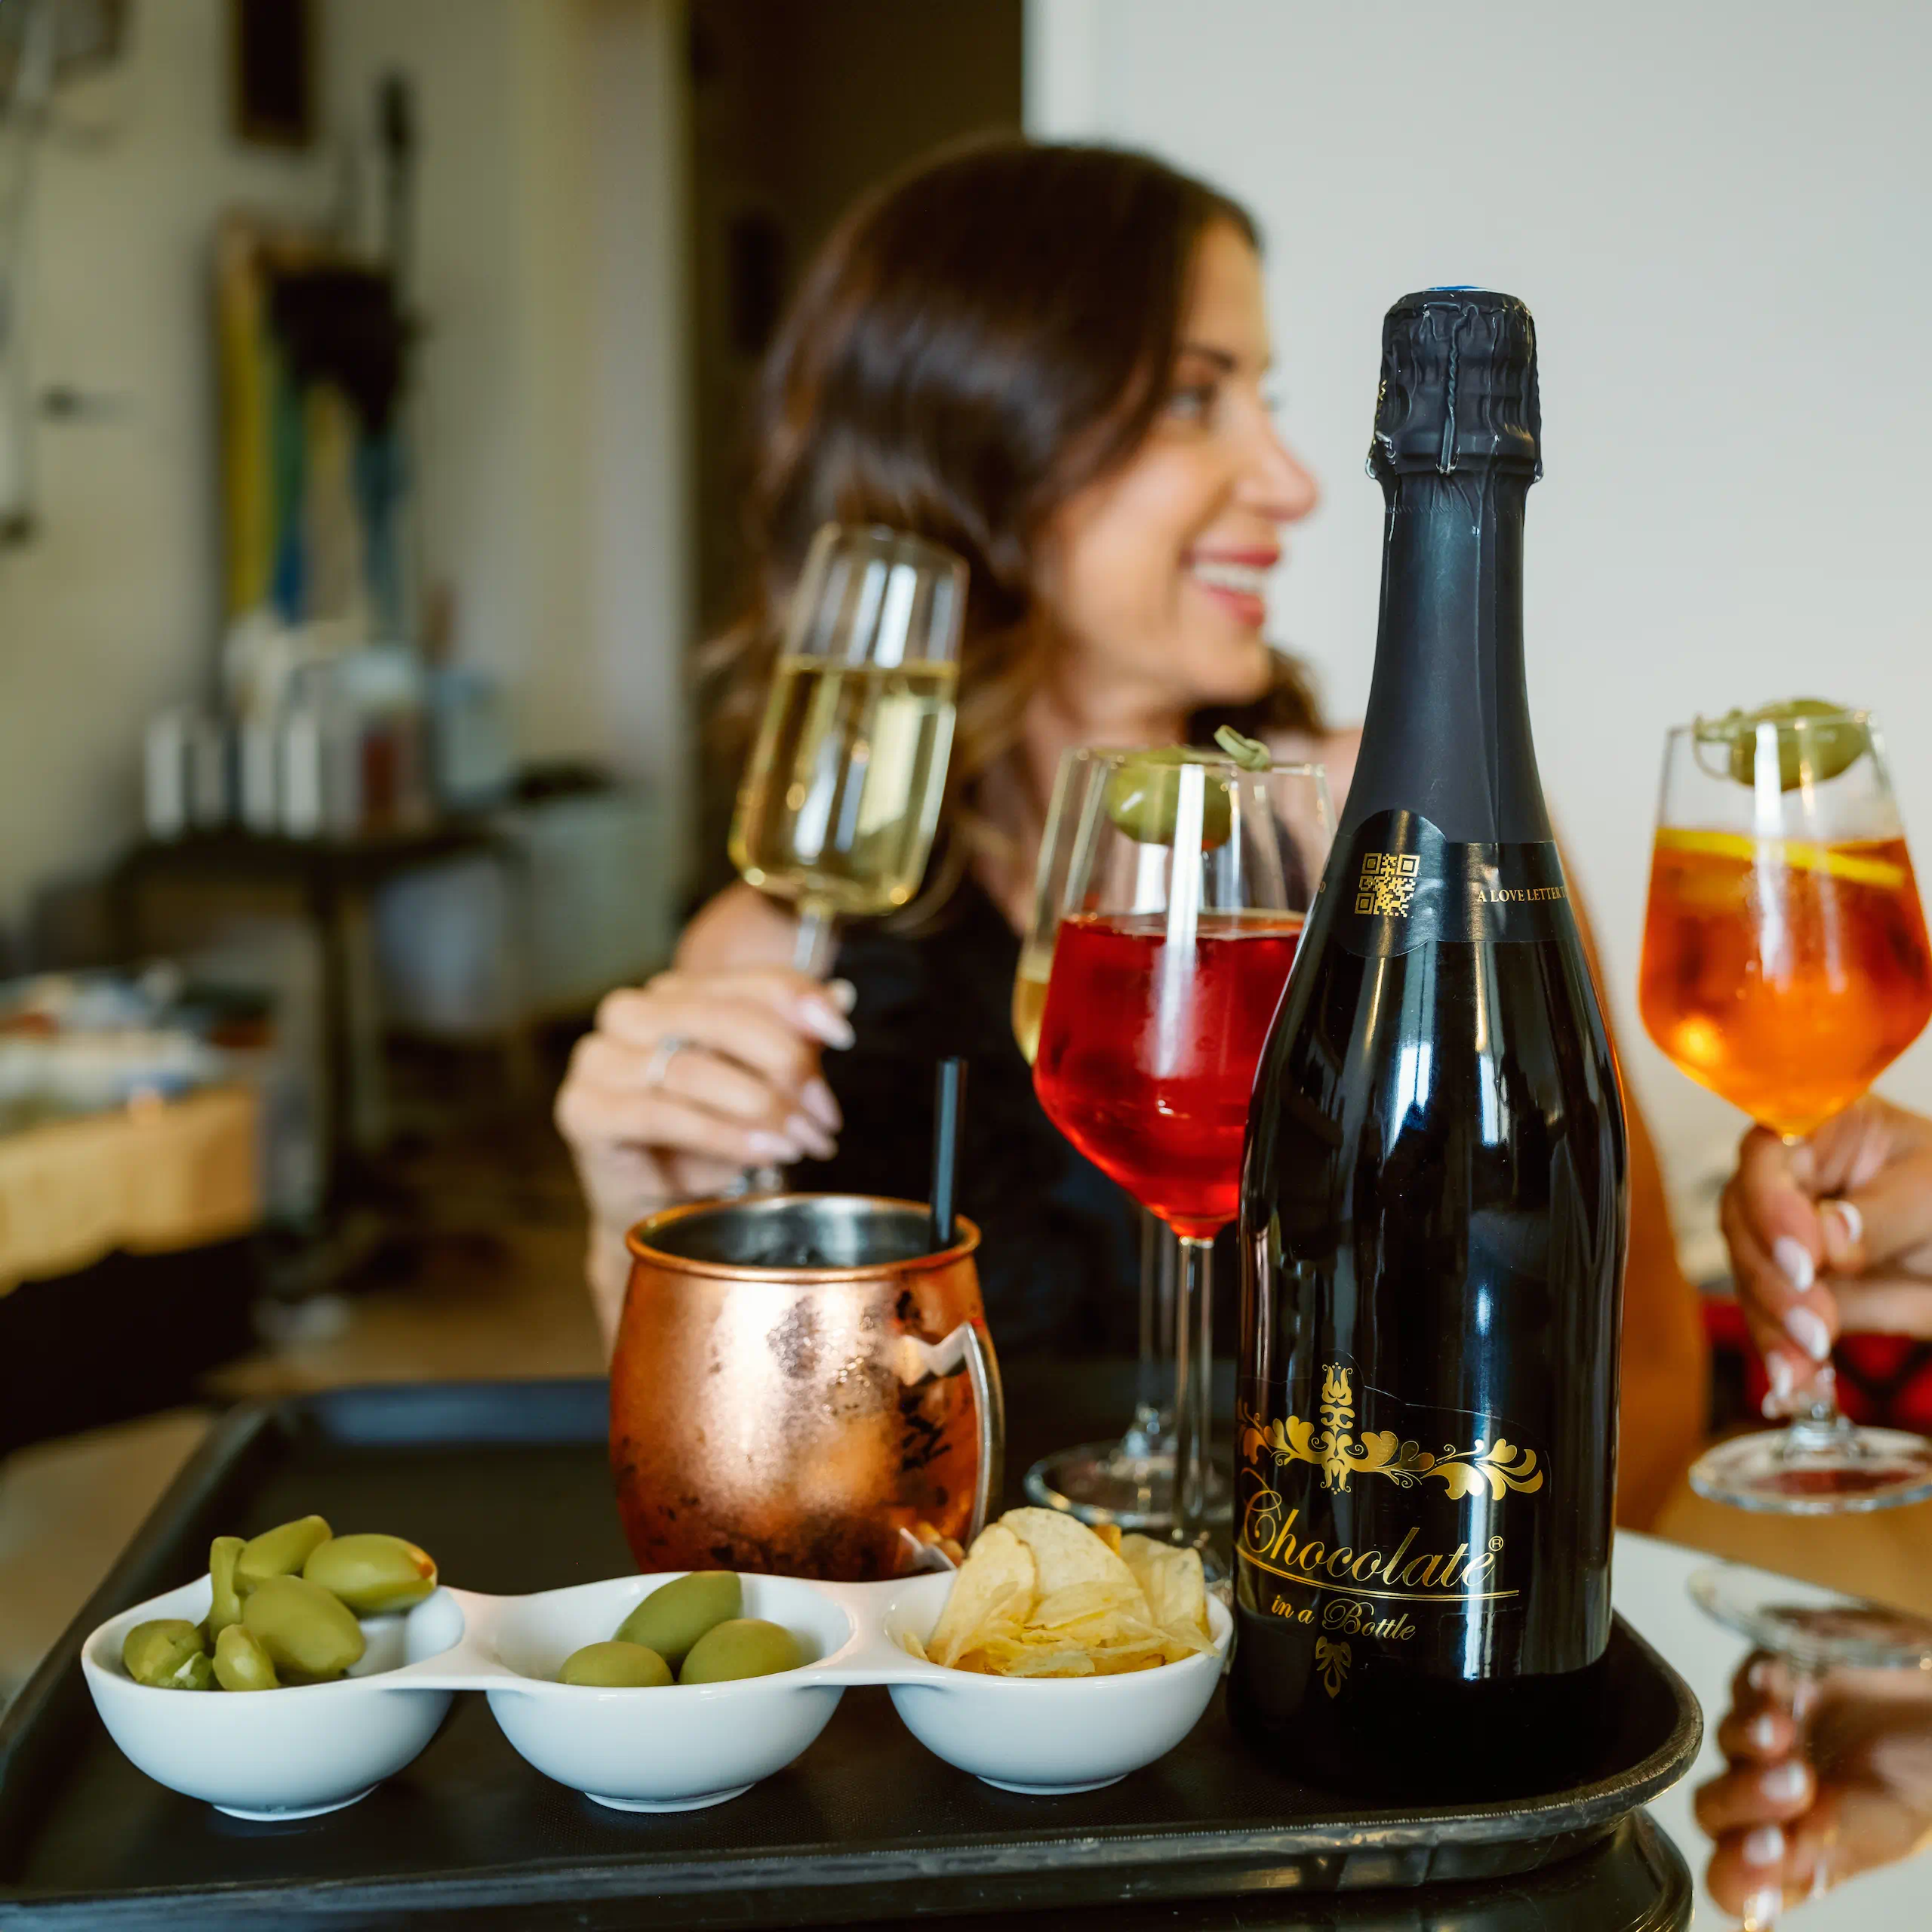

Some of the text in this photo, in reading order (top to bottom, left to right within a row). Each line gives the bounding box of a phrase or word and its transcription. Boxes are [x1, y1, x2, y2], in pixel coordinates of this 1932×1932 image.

[1477, 890, 1487, 903] A
[1490, 889, 1525, 903] LOVE
[1526, 887, 1562, 901] LETTER
[1271, 1595, 1416, 1641] in a Bottle
